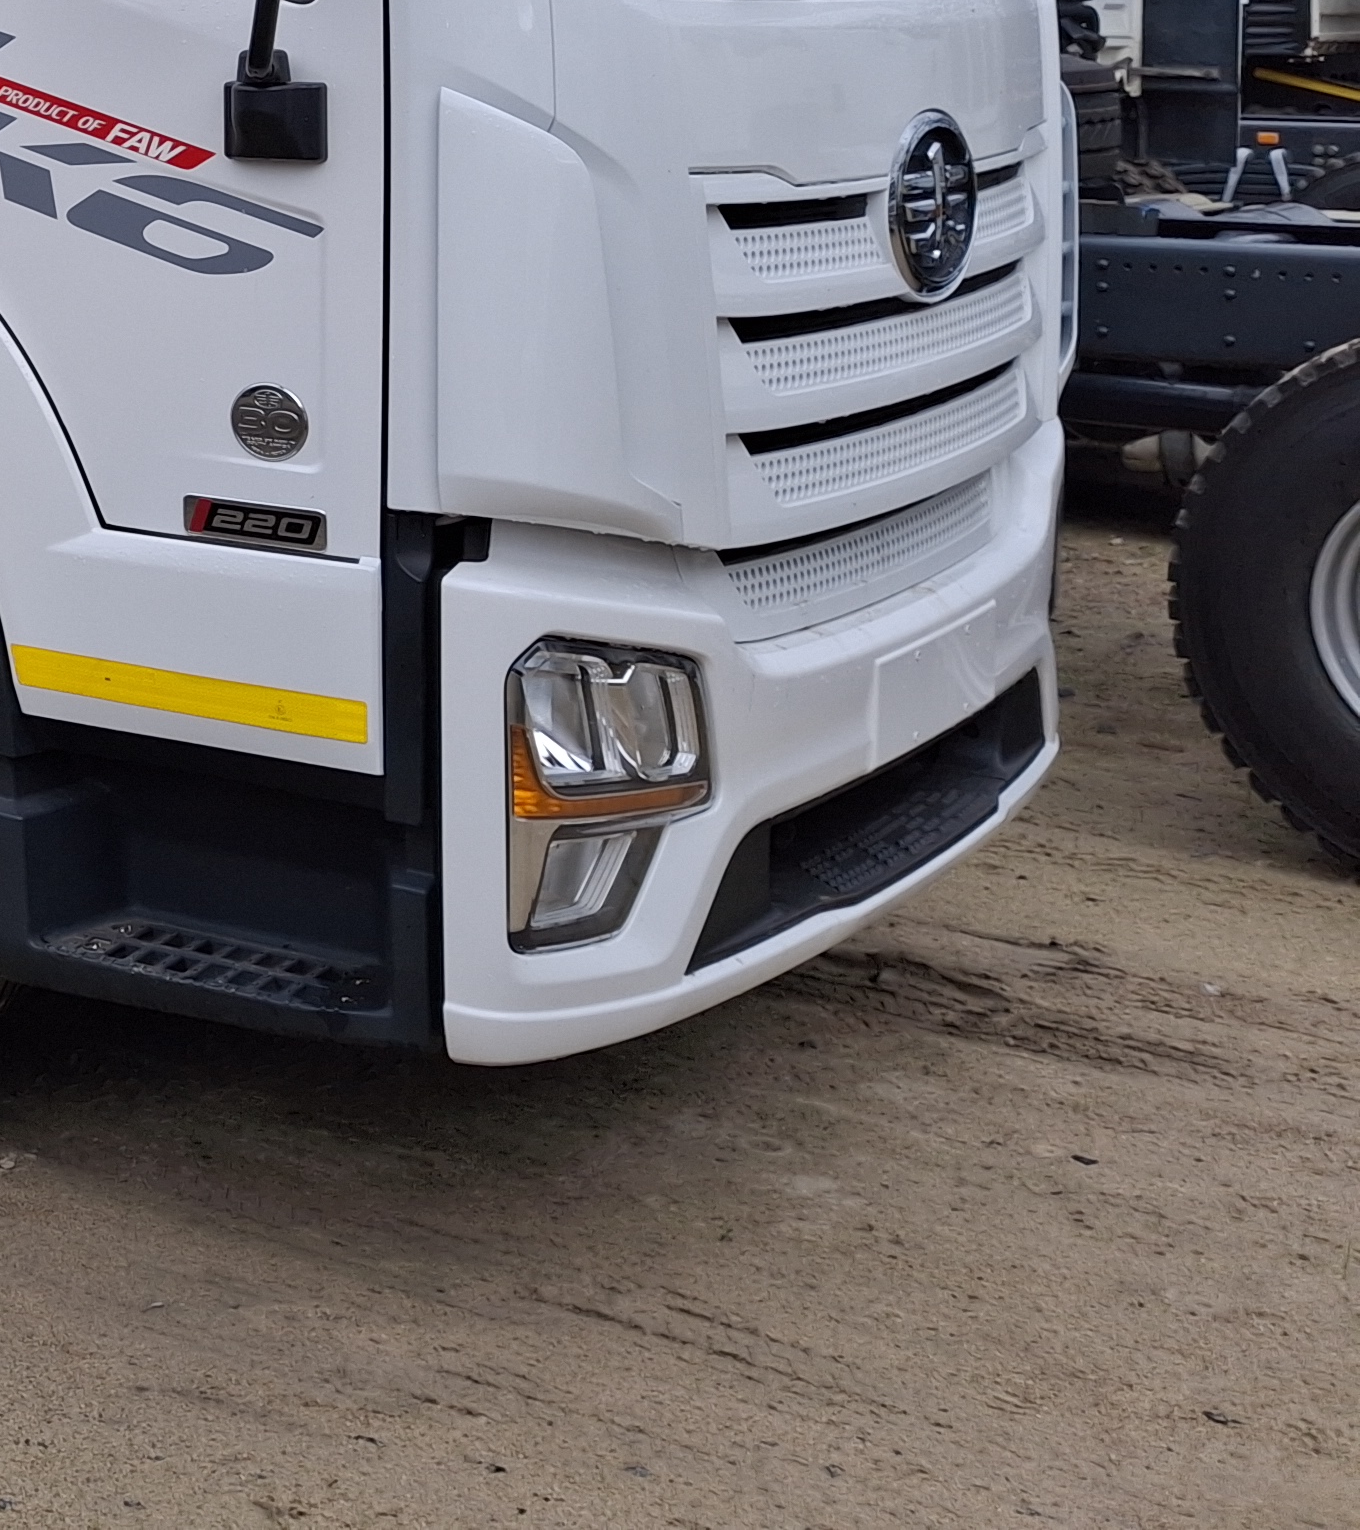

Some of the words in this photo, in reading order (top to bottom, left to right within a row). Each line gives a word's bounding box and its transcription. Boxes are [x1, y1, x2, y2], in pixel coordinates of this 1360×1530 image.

[77, 115, 107, 132] OF
[104, 122, 187, 162] FAW
[211, 508, 313, 540] 220
